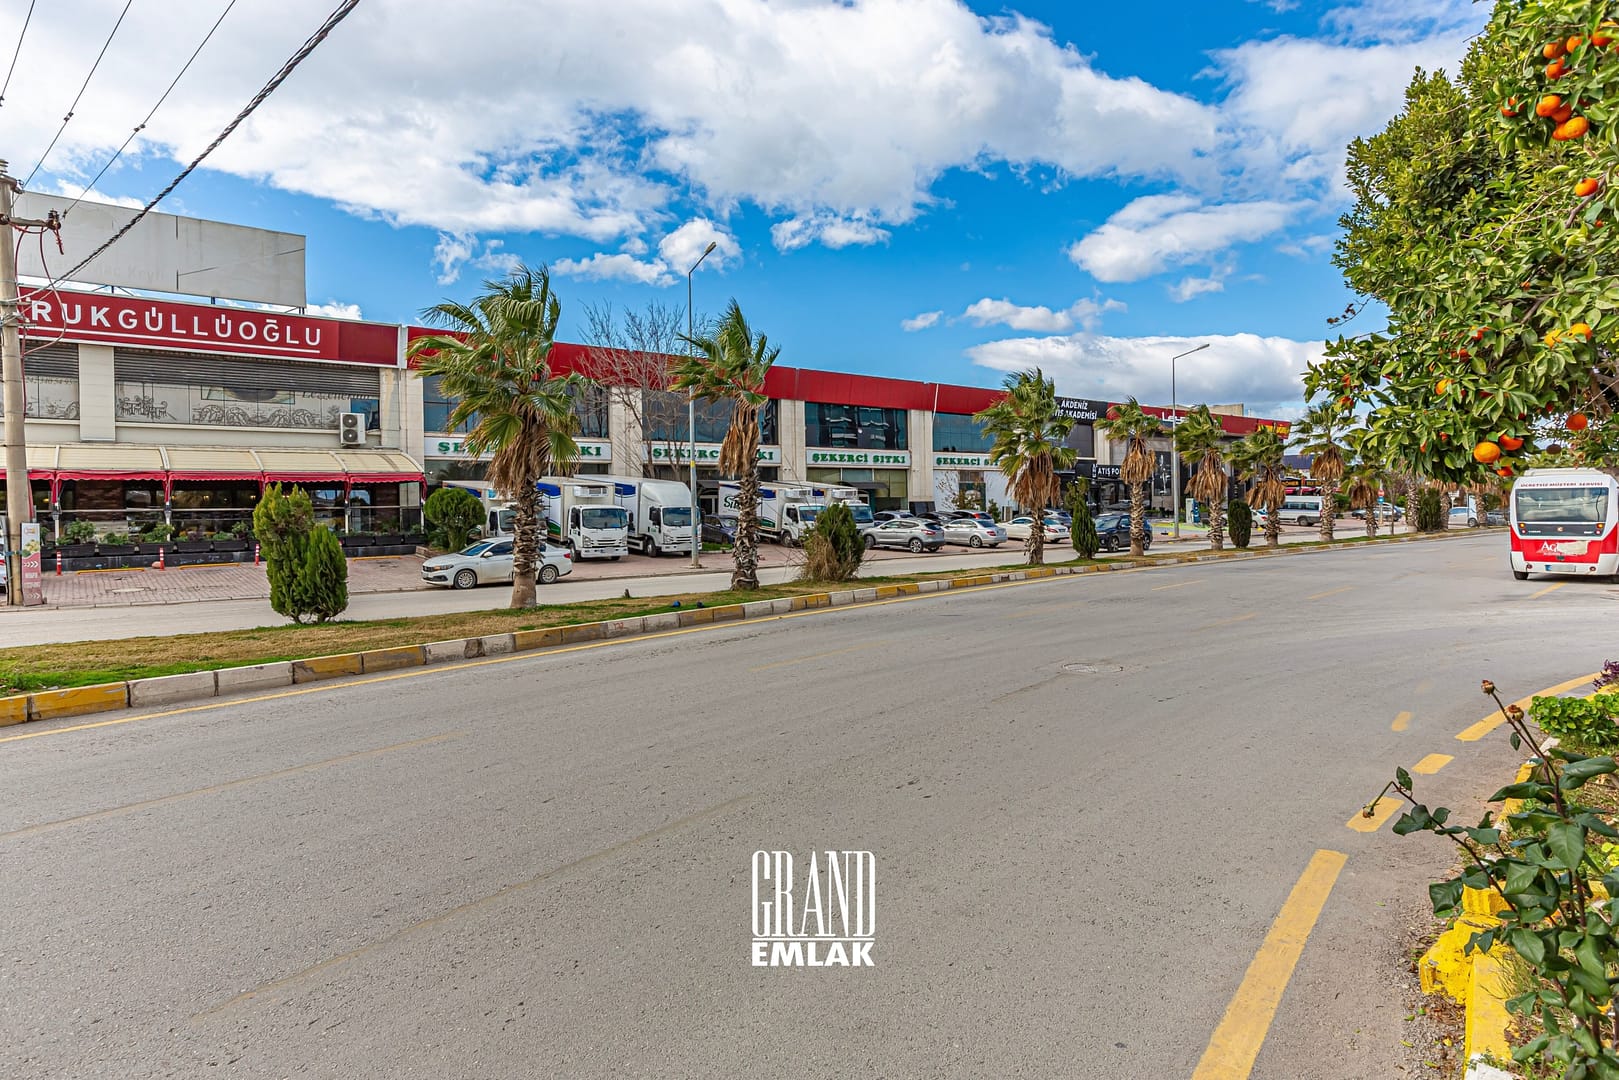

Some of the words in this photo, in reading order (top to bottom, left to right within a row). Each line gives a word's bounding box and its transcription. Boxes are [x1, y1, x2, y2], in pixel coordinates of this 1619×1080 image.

[652, 447, 720, 459] ŞEKERC
[812, 452, 869, 464] ŞEKERCİ
[936, 456, 980, 466] ŞEKERCİ
